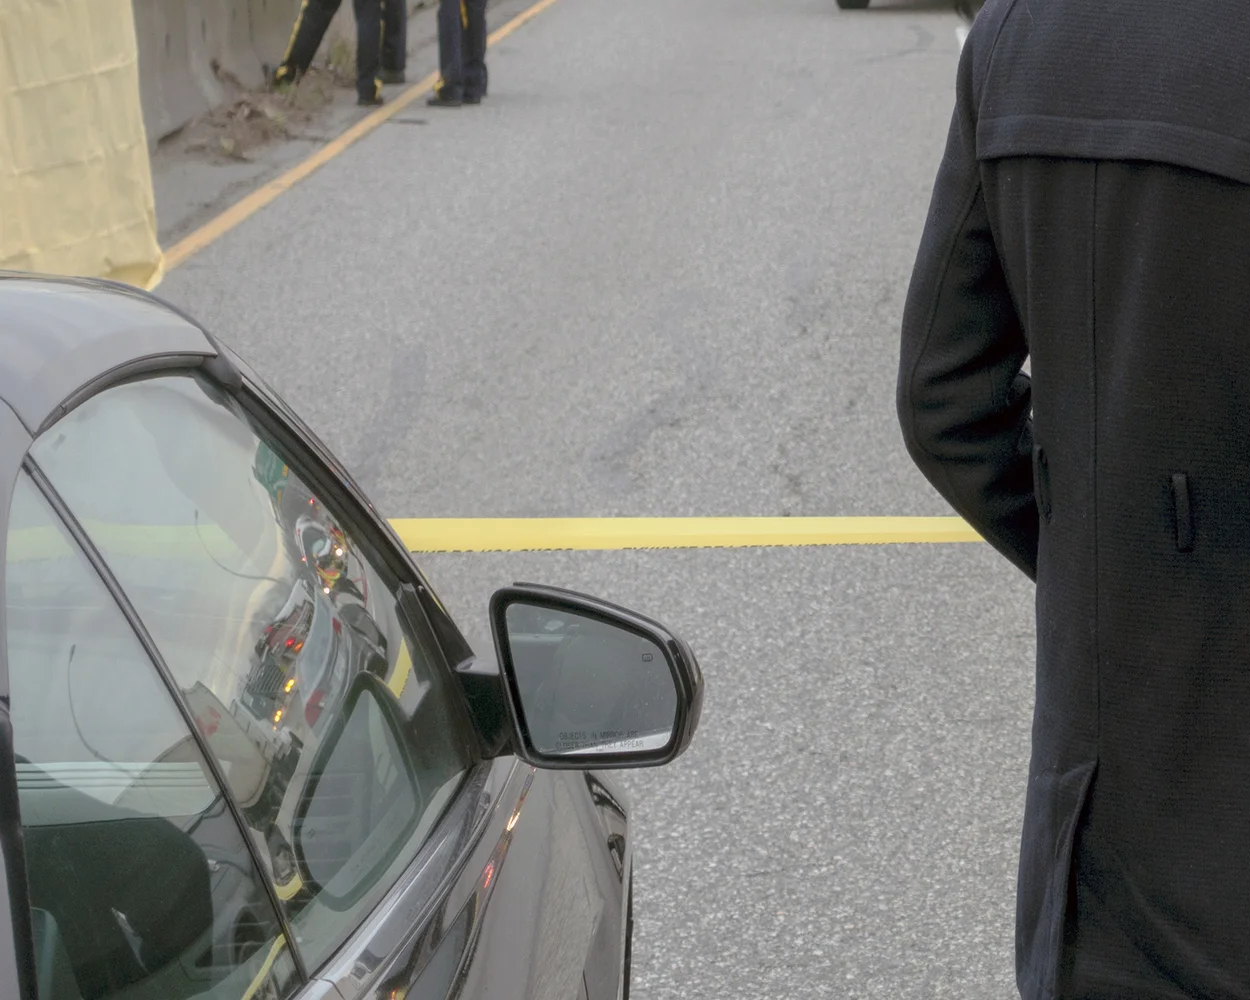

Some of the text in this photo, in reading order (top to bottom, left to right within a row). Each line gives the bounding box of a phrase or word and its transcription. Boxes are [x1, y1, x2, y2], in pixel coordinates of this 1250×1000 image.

[559, 731, 587, 740] OBJECTS
[599, 730, 624, 739] MIRROR
[626, 730, 639, 738] ARE
[555, 741, 580, 750] CLOSER
[620, 740, 644, 748] APPEAR
